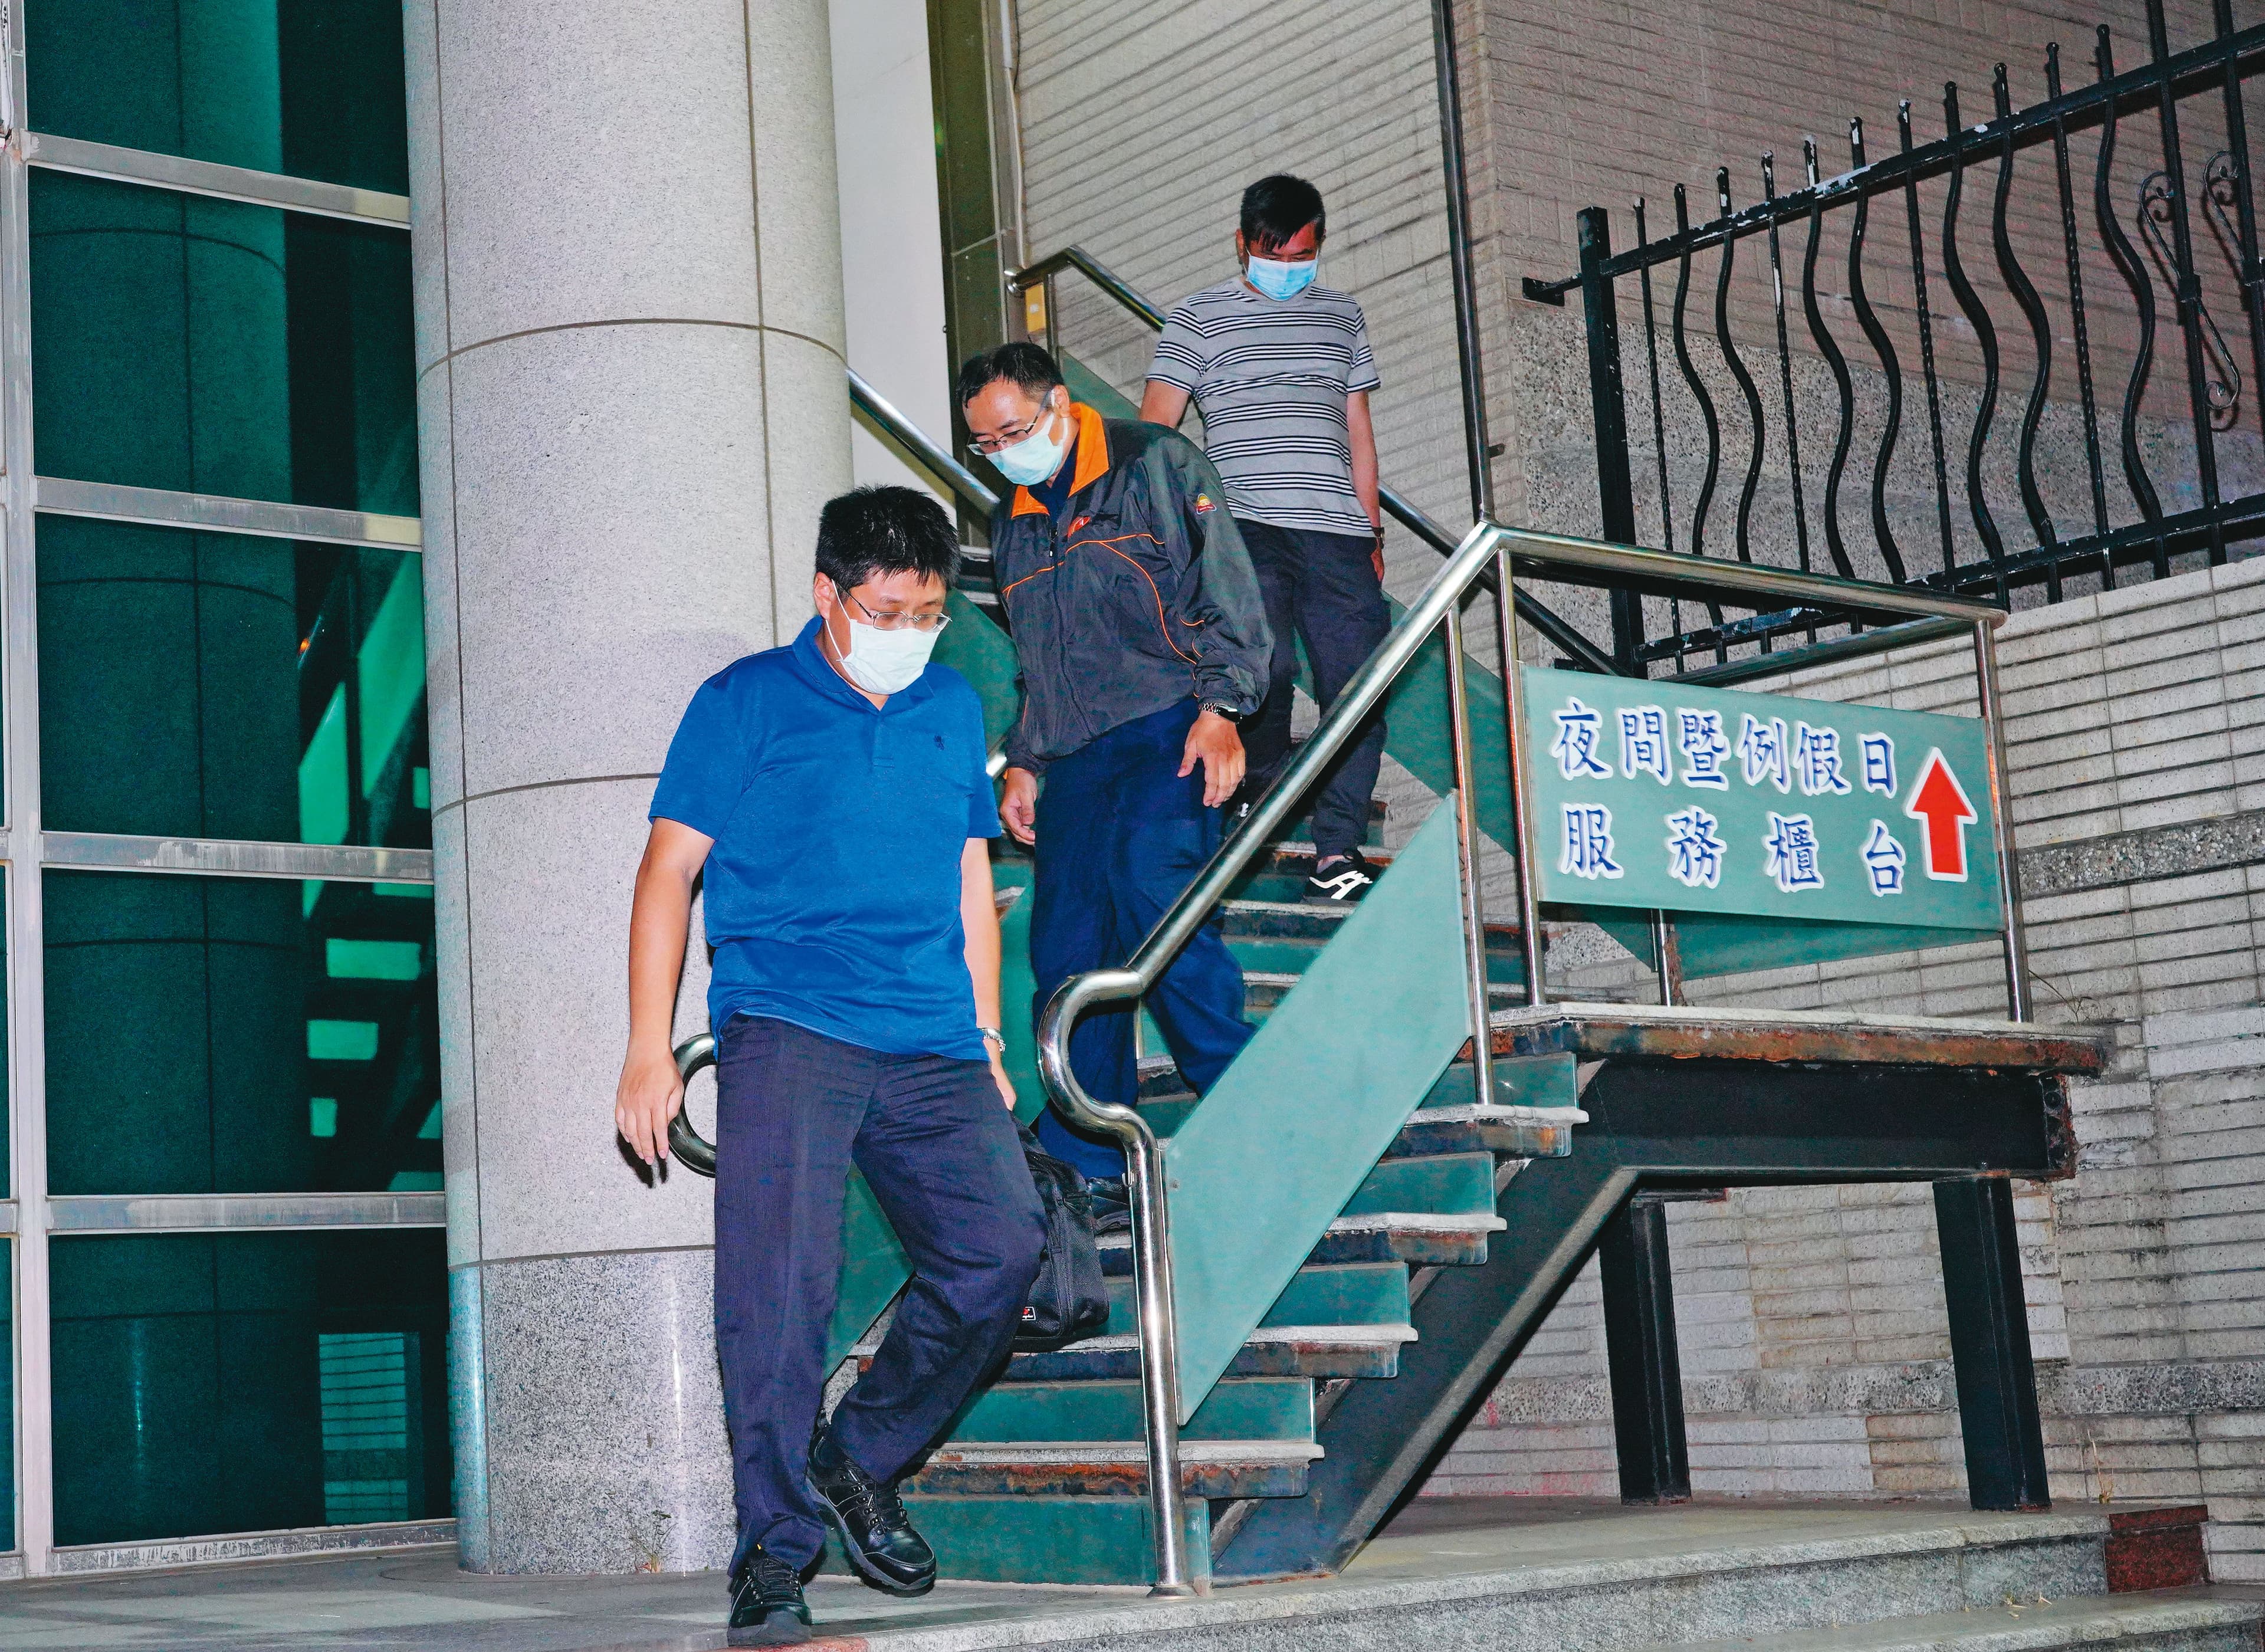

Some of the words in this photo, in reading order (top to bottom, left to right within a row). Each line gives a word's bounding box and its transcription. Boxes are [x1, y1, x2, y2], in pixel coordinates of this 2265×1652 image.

[1555, 699, 1896, 796] 夜間暨例假日
[1562, 806, 1905, 894] 服務櫃台
